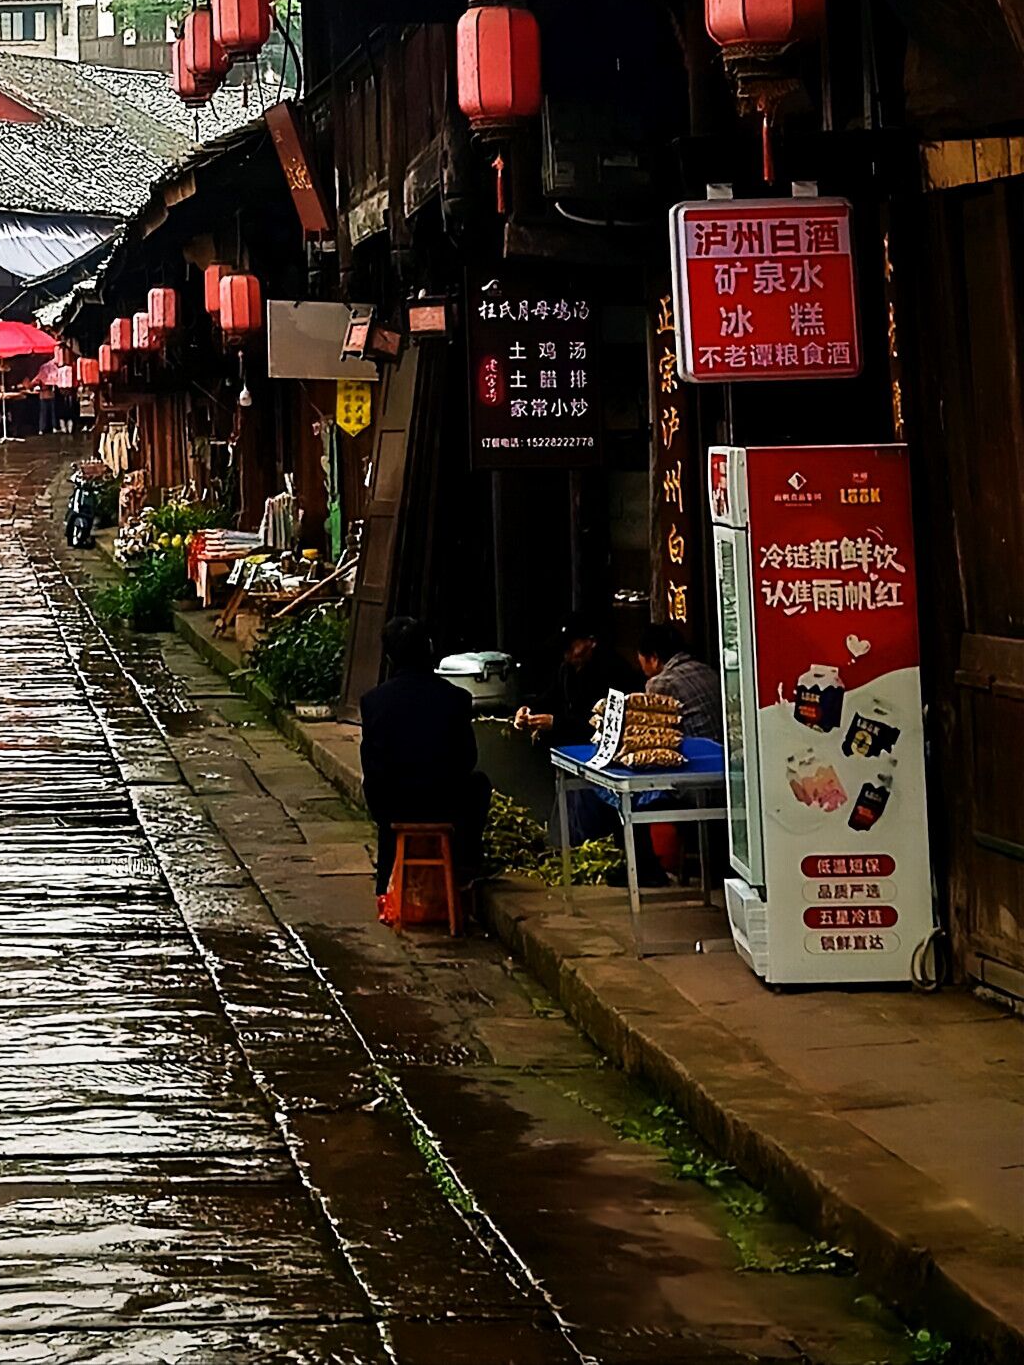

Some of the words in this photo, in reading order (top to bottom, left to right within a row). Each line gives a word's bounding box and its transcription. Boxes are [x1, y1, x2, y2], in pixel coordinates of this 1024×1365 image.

[694, 219, 840, 256] 泸州白酒
[714, 259, 825, 295] 矿泉水
[719, 302, 826, 338] 冰糕
[508, 340, 587, 360] 土鸡汤
[509, 369, 588, 389] 土腊排
[510, 398, 590, 418] 家常小炒
[656, 294, 688, 624] 正宗泸州白酒
[759, 536, 907, 574] 冷链新鲜饮
[760, 578, 905, 613] 认准雨帆红
[817, 858, 881, 874] 低温短保
[817, 883, 881, 899] 品质严选
[819, 909, 883, 925] 五星冷链
